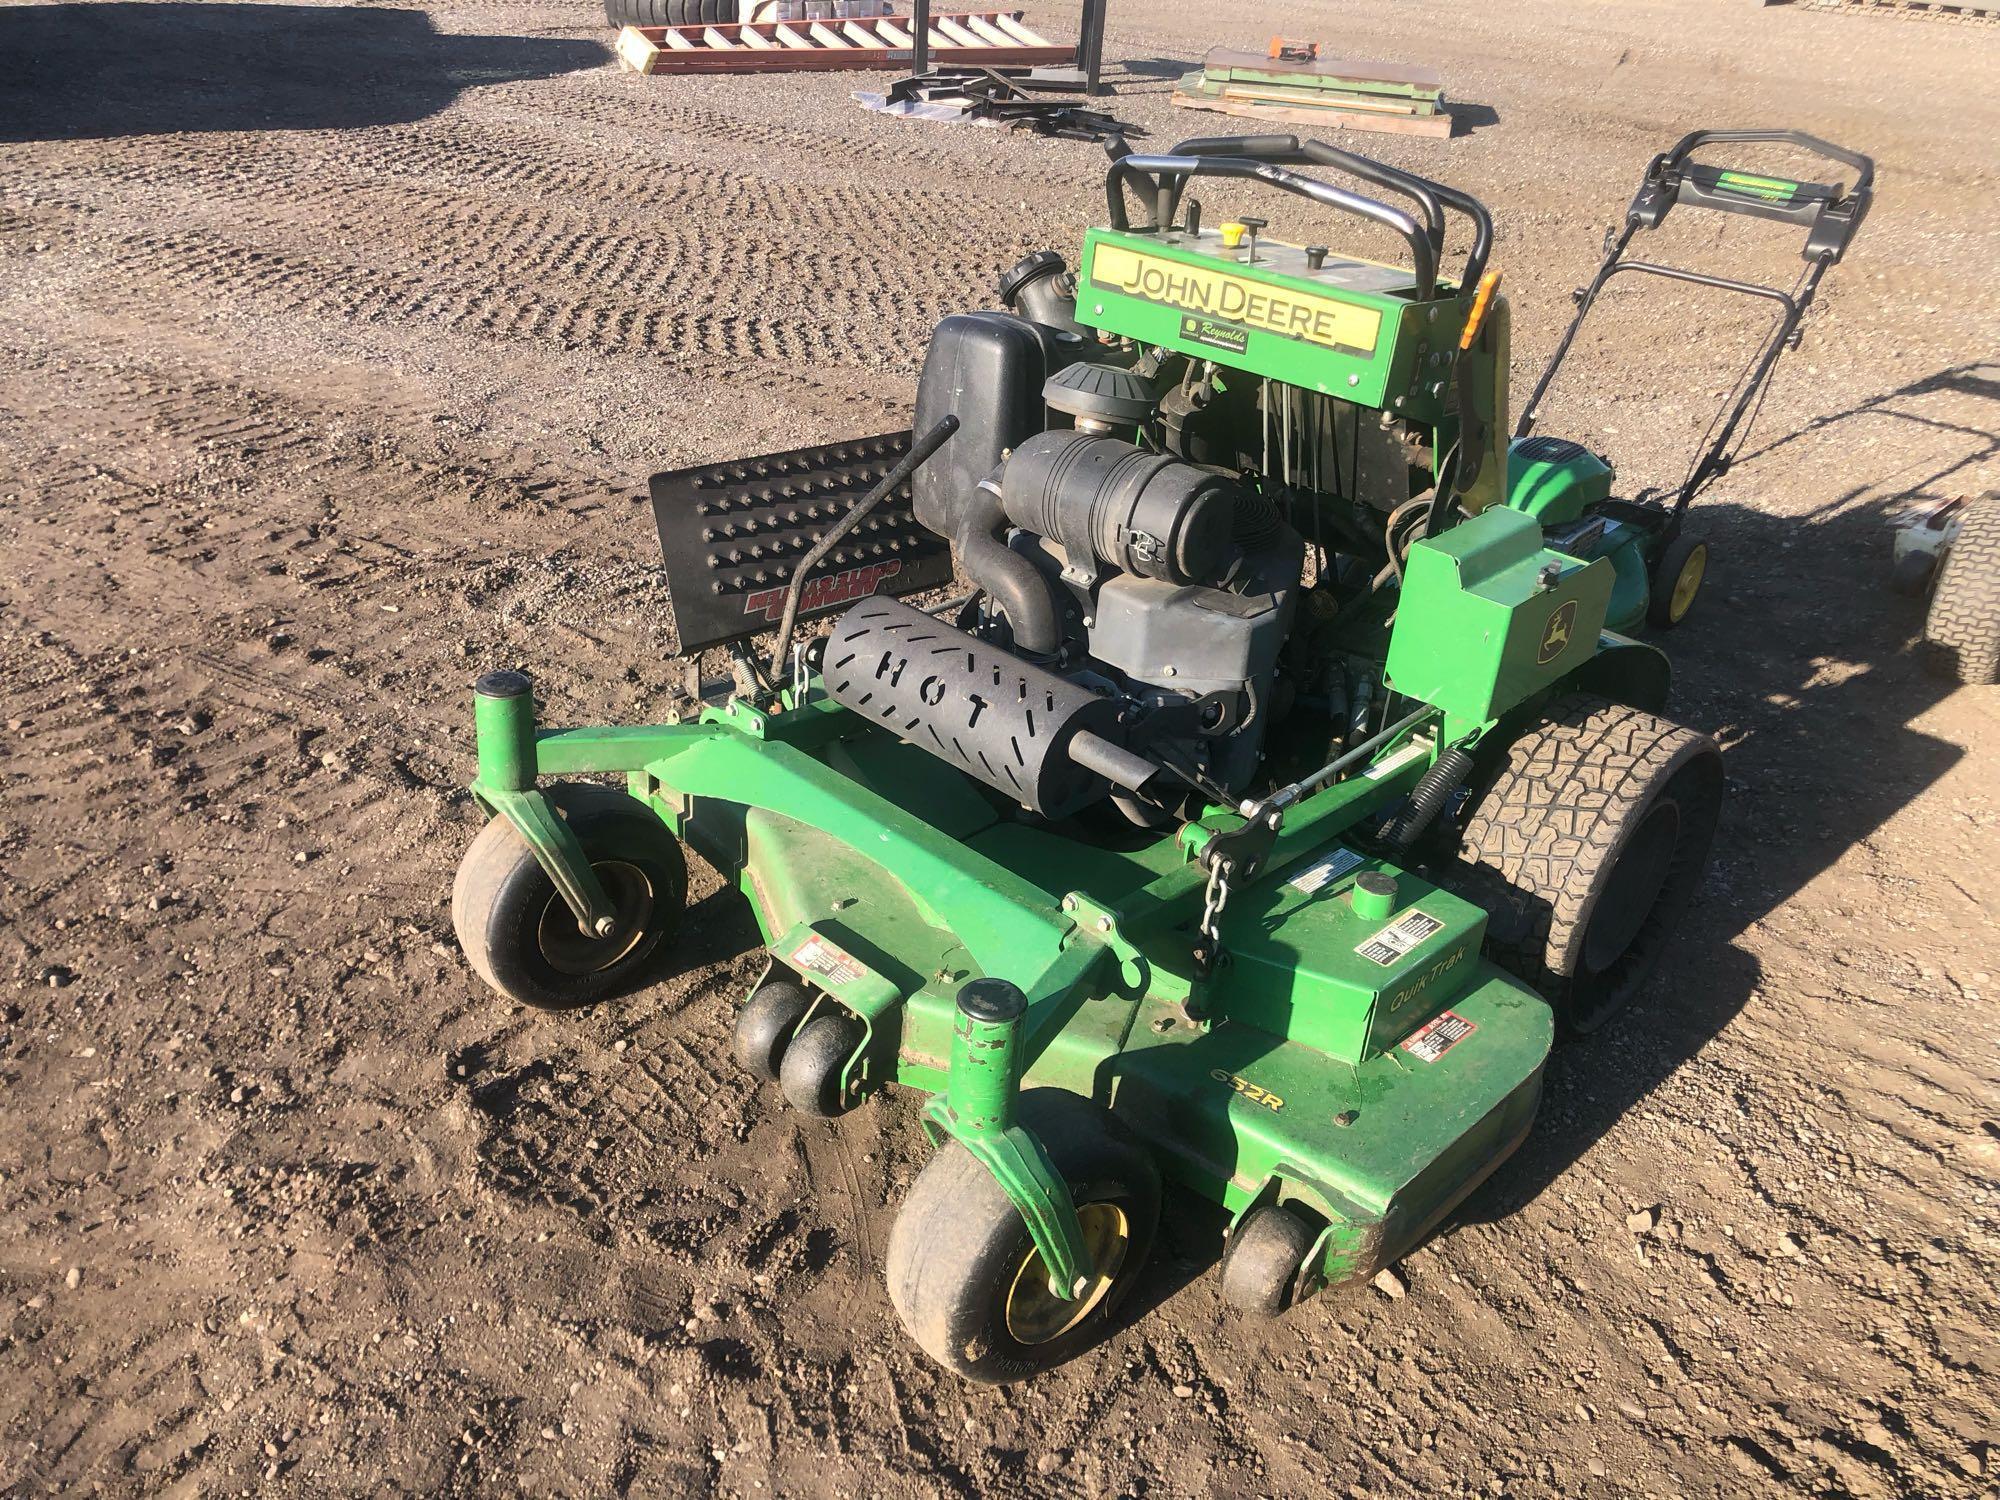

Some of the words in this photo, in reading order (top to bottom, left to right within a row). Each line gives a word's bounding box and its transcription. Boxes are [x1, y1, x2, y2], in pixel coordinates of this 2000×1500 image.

[1123, 259, 1212, 307] JOHN
[1219, 280, 1336, 340] DEERE
[1200, 321, 1246, 343] Reynolds
[875, 650, 993, 729] HOT
[1209, 1067, 1285, 1112] 652R
